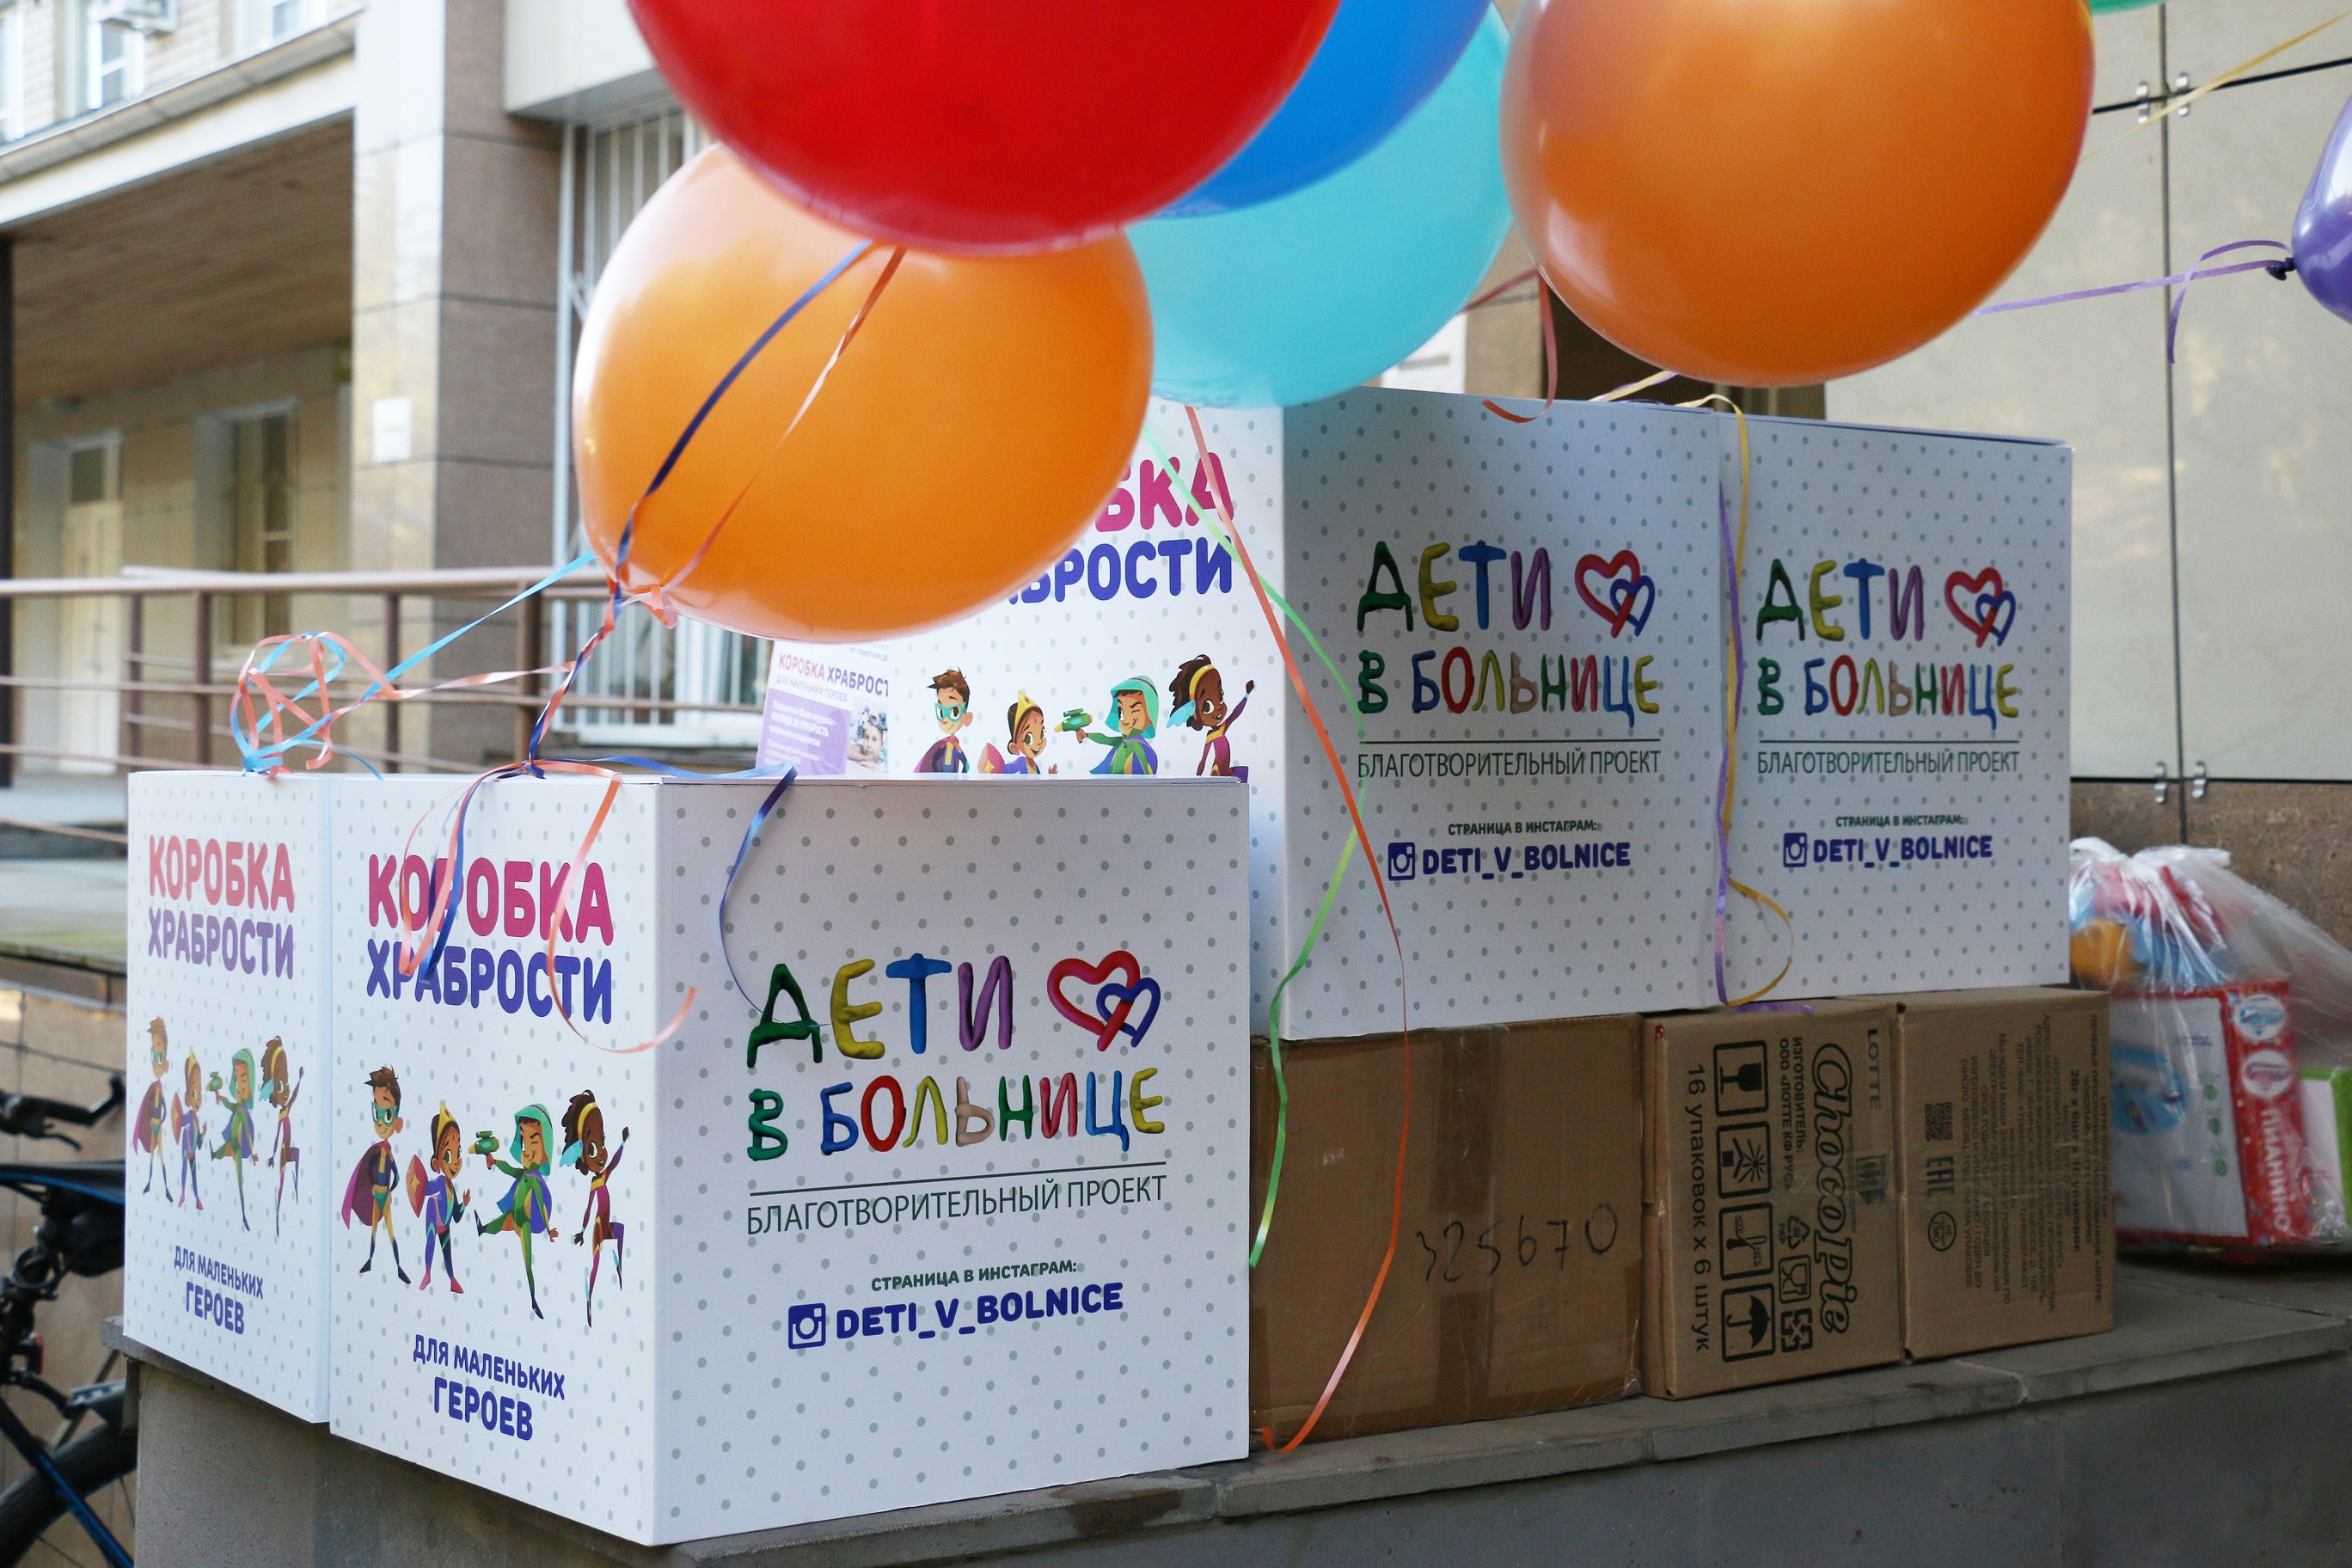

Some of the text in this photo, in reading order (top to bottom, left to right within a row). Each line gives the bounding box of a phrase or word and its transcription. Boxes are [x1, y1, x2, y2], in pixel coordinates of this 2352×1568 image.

[1009, 535, 1232, 604] РОСТИ
[1357, 541, 1551, 632] ДЕТИ
[1756, 558, 1924, 641] ДЕТИ
[778, 652, 889, 698] КОРОБКА ХРАБРОСТ
[1357, 646, 1660, 728] В БОЛЬНИЦЕ
[1757, 654, 2019, 731] В БОЛЬНИЦЕ
[1357, 748, 1661, 778] БЛАГОТВОРИТЕЛЬНЫЙ ПРОЕКТ
[1757, 748, 2020, 774] БЛАГОТВОРИТЕЛЬНЫЙ ПРОЕКТ
[1449, 819, 1597, 836] СТРАНИЦА В ИНСТАГРАМ:
[1813, 835, 1993, 868] DETI_V_BOLNICE
[1835, 815, 1890, 828] СТРАНИЦА
[1893, 816, 1900, 826] В
[148, 835, 295, 914] КОРОБКА
[1423, 842, 1631, 880] DETI_V_BOLNICE
[148, 907, 294, 980] ХРАБРОСТИ
[366, 938, 612, 1025] ХРАБРОСТИ
[746, 952, 1014, 1068] ДЕТИ
[1687, 1063, 1706, 1095] 16
[1779, 1038, 1791, 1071] ООО
[1866, 1028, 1882, 1111] LOTTE
[746, 1067, 1165, 1161] В БОЛЬНИЦЕ
[1780, 1075, 1792, 1128] «ЛОТТЕ
[1792, 1037, 1806, 1153] ИЗГОТОВИТЕЛЬ:
[1685, 1105, 1709, 1226] упаковок
[1782, 1131, 1793, 1152] КФ
[746, 1174, 1167, 1235] БЛАГОТВОРИТЕЛЬНЫЙ ПРОЕКТ
[174, 1245, 264, 1300] ДЛЯ МАЛЕНЬКИХ
[871, 1259, 1077, 1292] СТРАНИЦА В ИНСТАГРАМ:
[1694, 1259, 1712, 1275] 6
[186, 1281, 245, 1335] ГЕРОЕВ
[836, 1282, 1124, 1339] DETI_V_BOLNICE
[1692, 1285, 1711, 1351] штук
[413, 1333, 566, 1400] ДЛЯ МАЛЕНЬКИХ
[433, 1375, 533, 1442] ГЕРОЕВ
